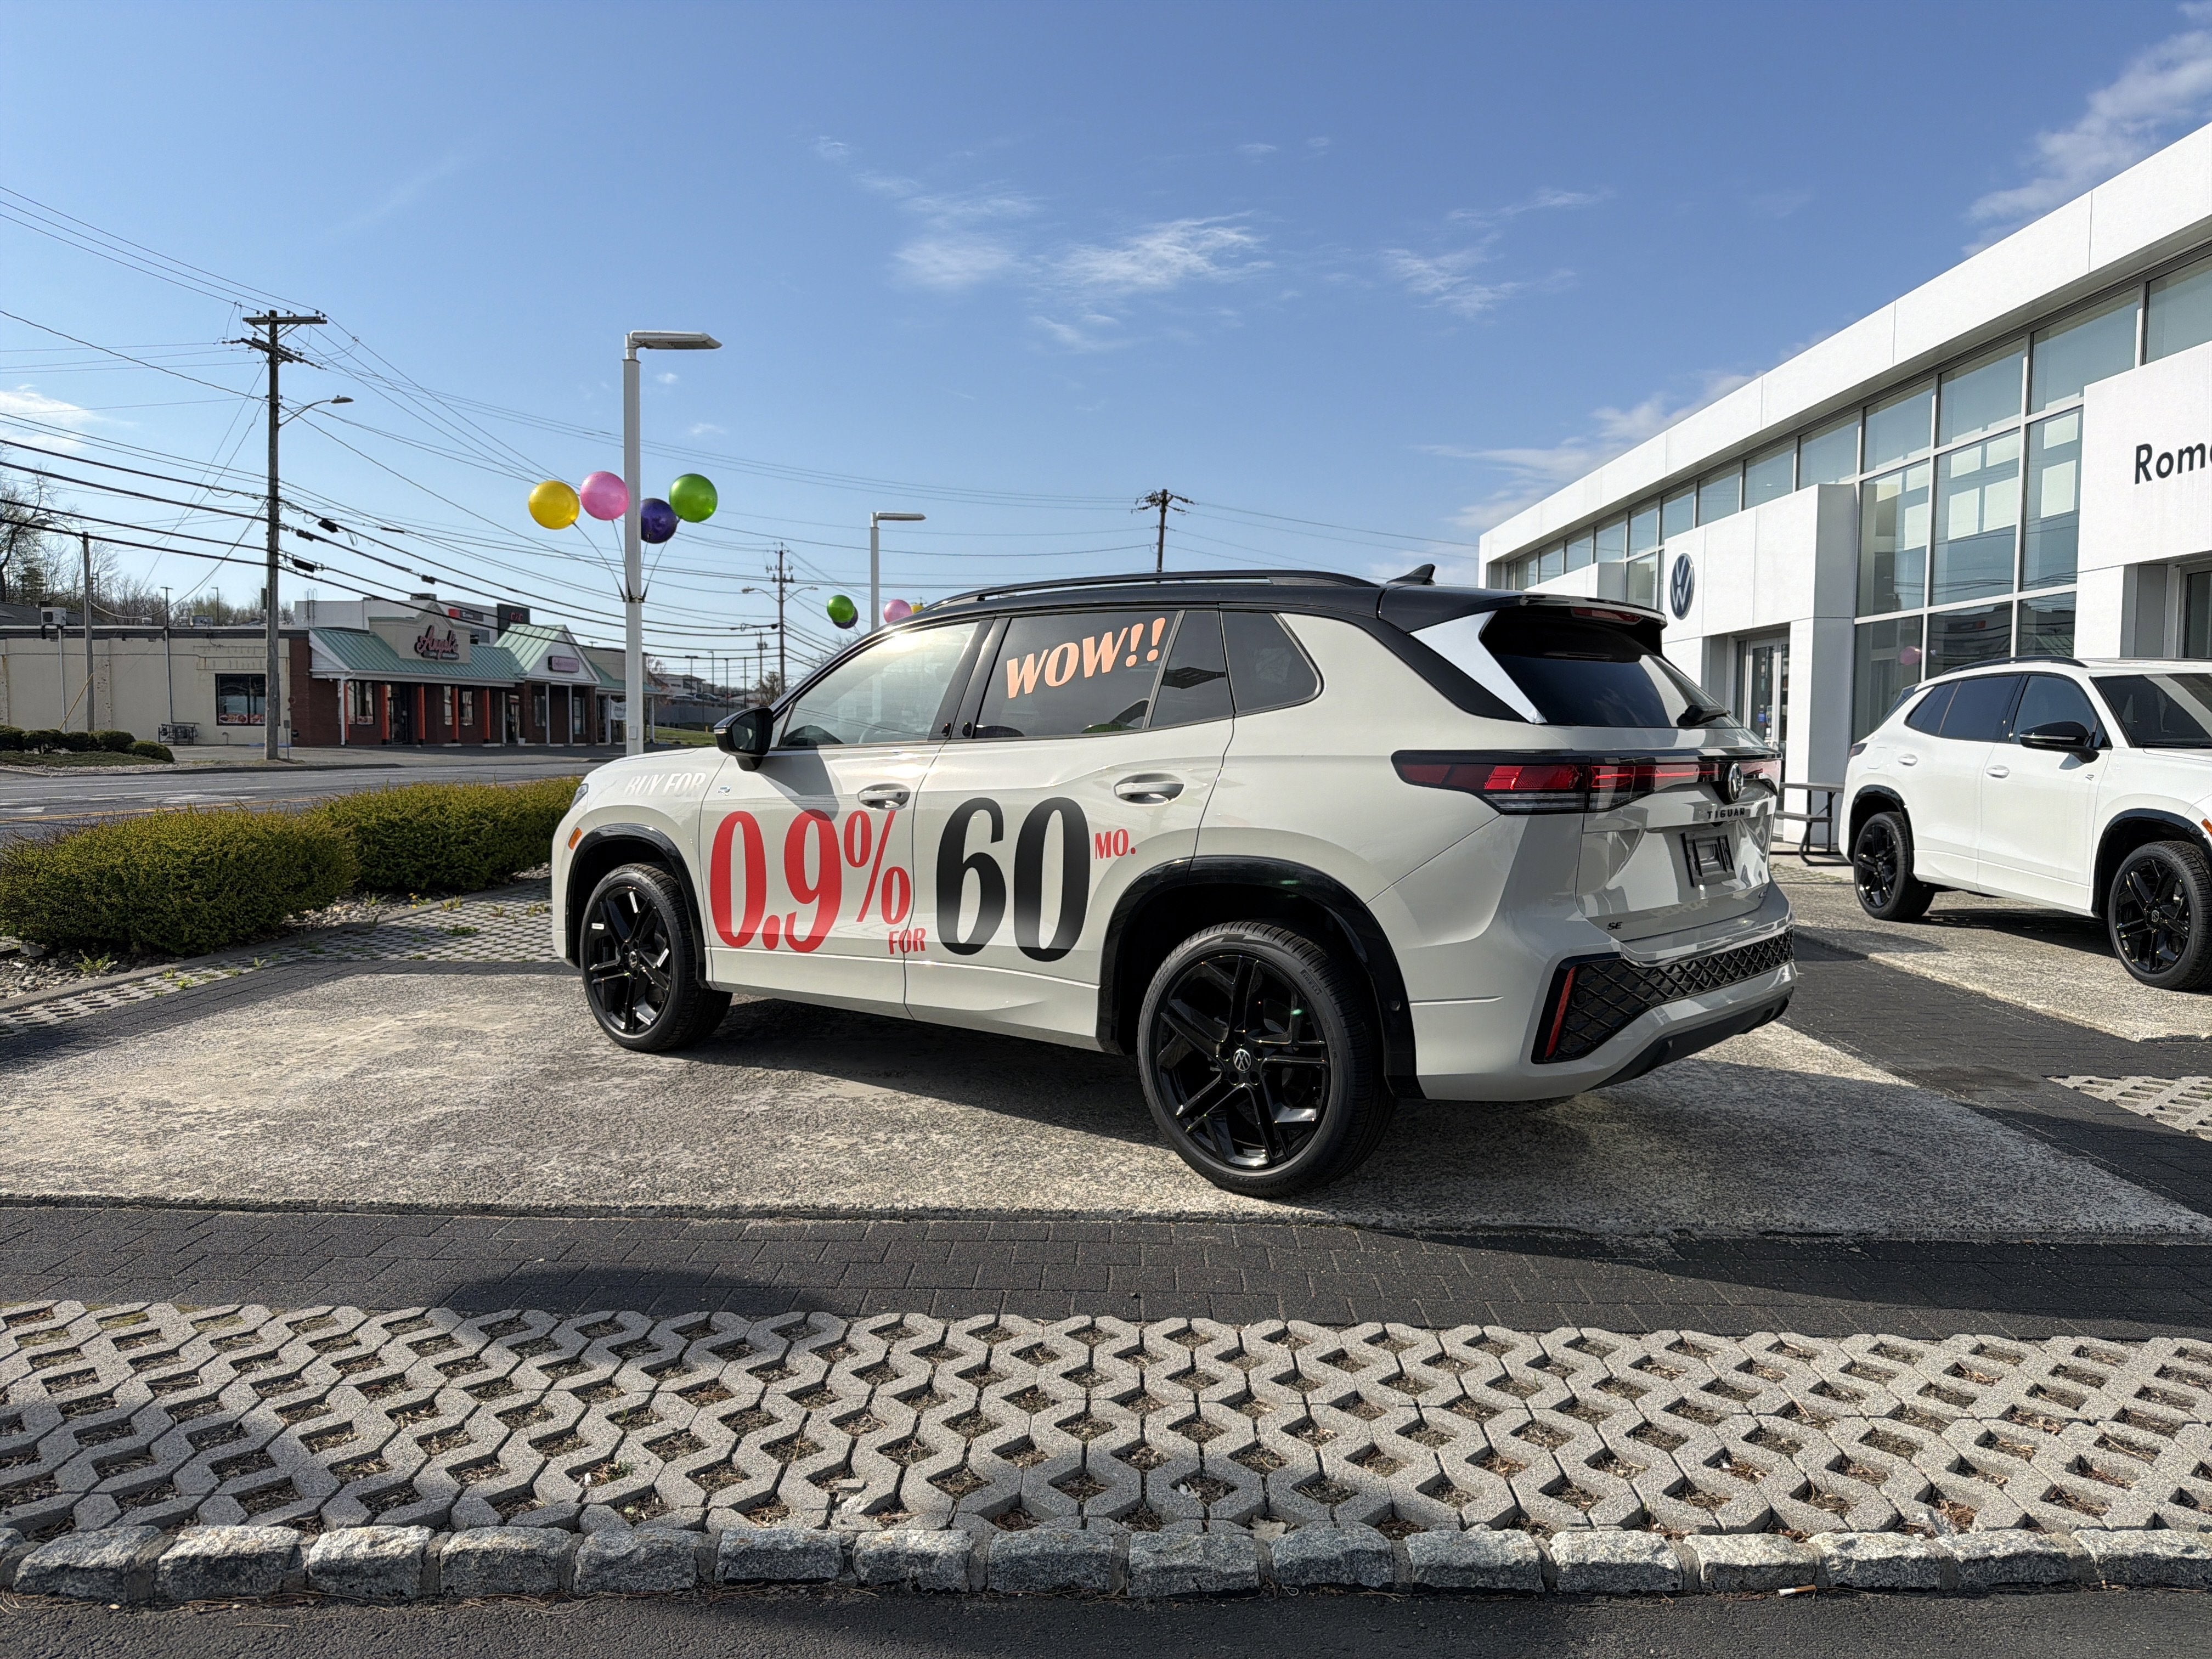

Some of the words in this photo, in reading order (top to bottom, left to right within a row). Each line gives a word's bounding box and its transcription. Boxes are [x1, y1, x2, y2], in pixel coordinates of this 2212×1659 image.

[2135, 443, 2212, 485] Rom
[1006, 617, 1166, 699] WOW!!
[624, 774, 665, 796] BUY
[663, 772, 707, 797] FOR
[1706, 807, 1745, 820] TIGUAN
[710, 809, 911, 953] 0.9%
[888, 927, 926, 955] FOR
[936, 796, 1091, 962] 60
[1094, 828, 1137, 860] MO.
[1607, 921, 1623, 930] SE
[1300, 969, 1323, 996] PIRELLI
